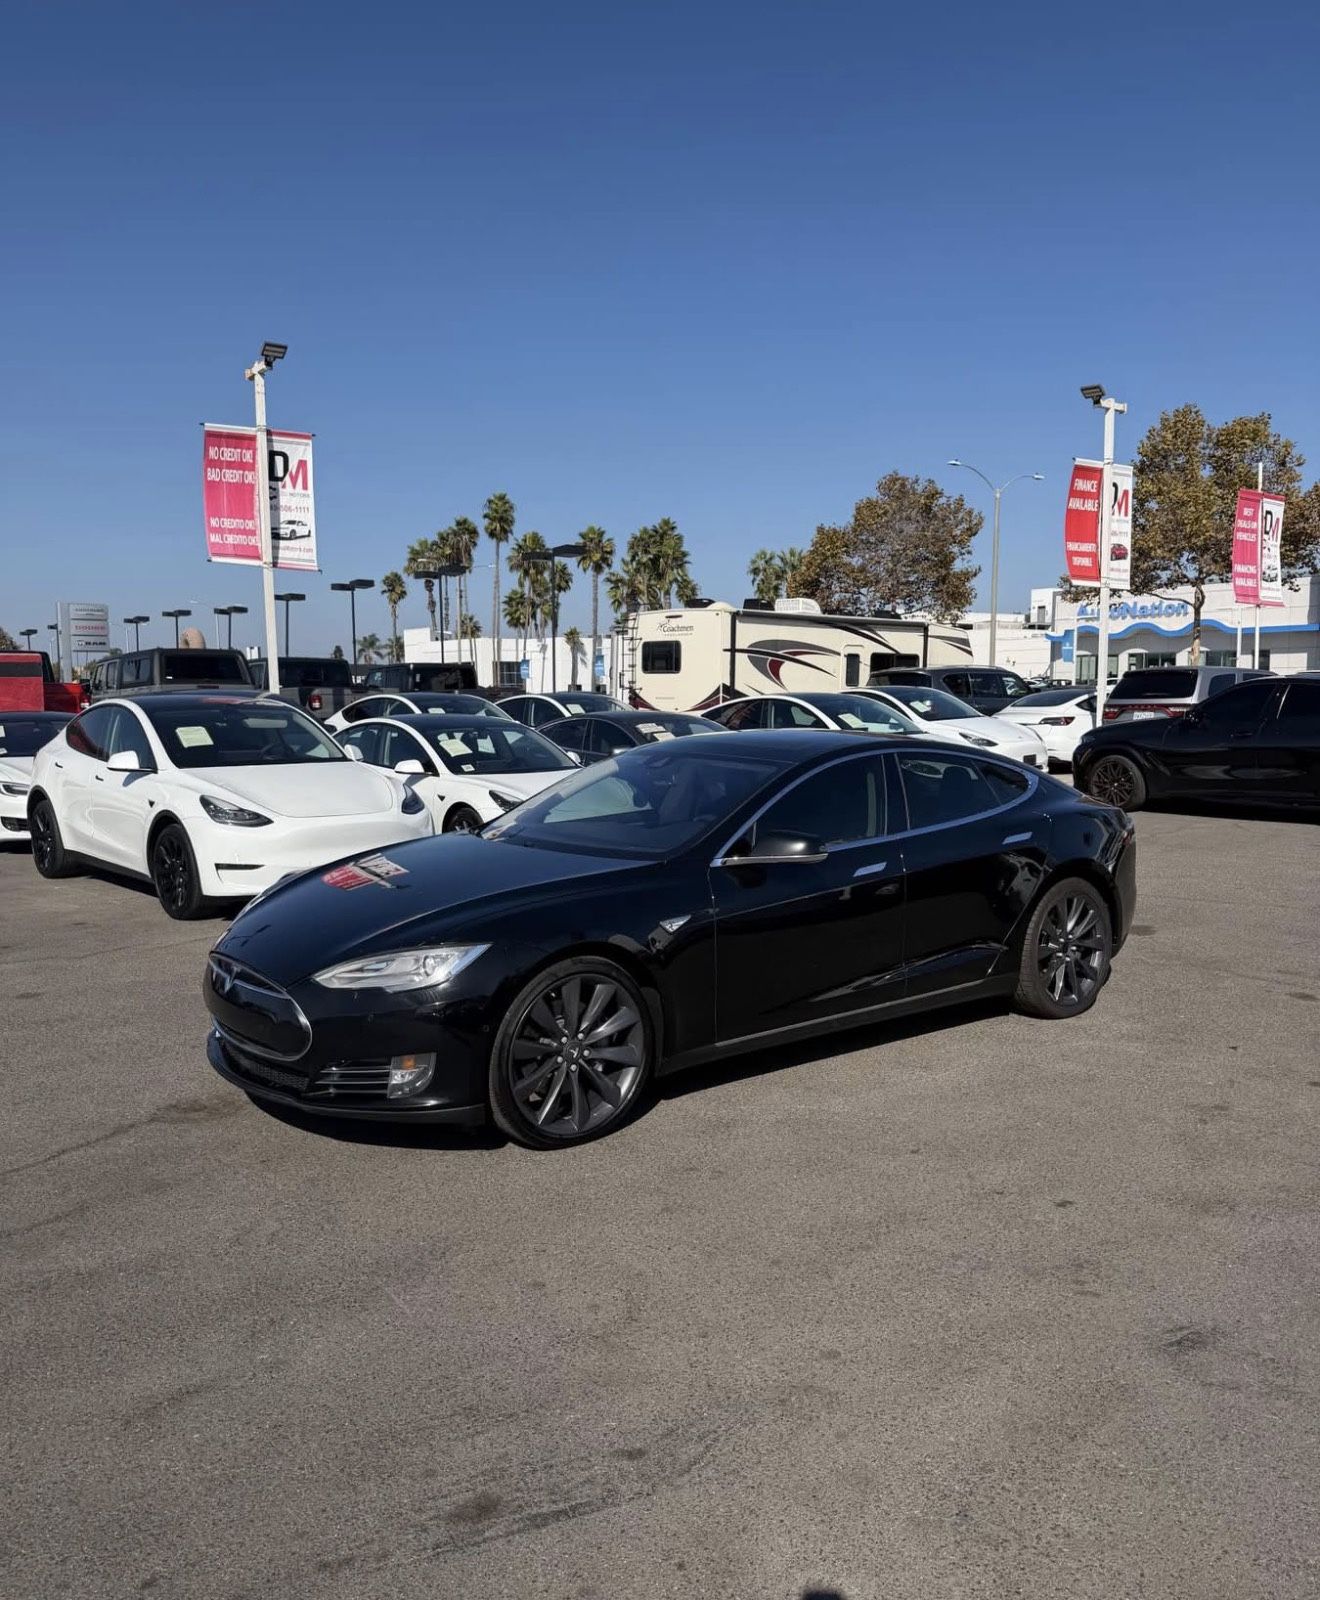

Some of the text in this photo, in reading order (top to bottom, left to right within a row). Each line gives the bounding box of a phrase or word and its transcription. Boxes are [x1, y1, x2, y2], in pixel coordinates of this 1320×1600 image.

[209, 446, 219, 460] NO
[220, 447, 241, 462] CREDIT
[207, 468, 220, 482] BAD
[221, 469, 243, 483] CREDIT
[1073, 479, 1097, 493] FINANCE
[1068, 496, 1098, 512] AVAILABLE
[210, 517, 220, 528] NO
[220, 518, 244, 529] CREDITO
[210, 533, 223, 544] MAL
[223, 534, 247, 545] CREDITO
